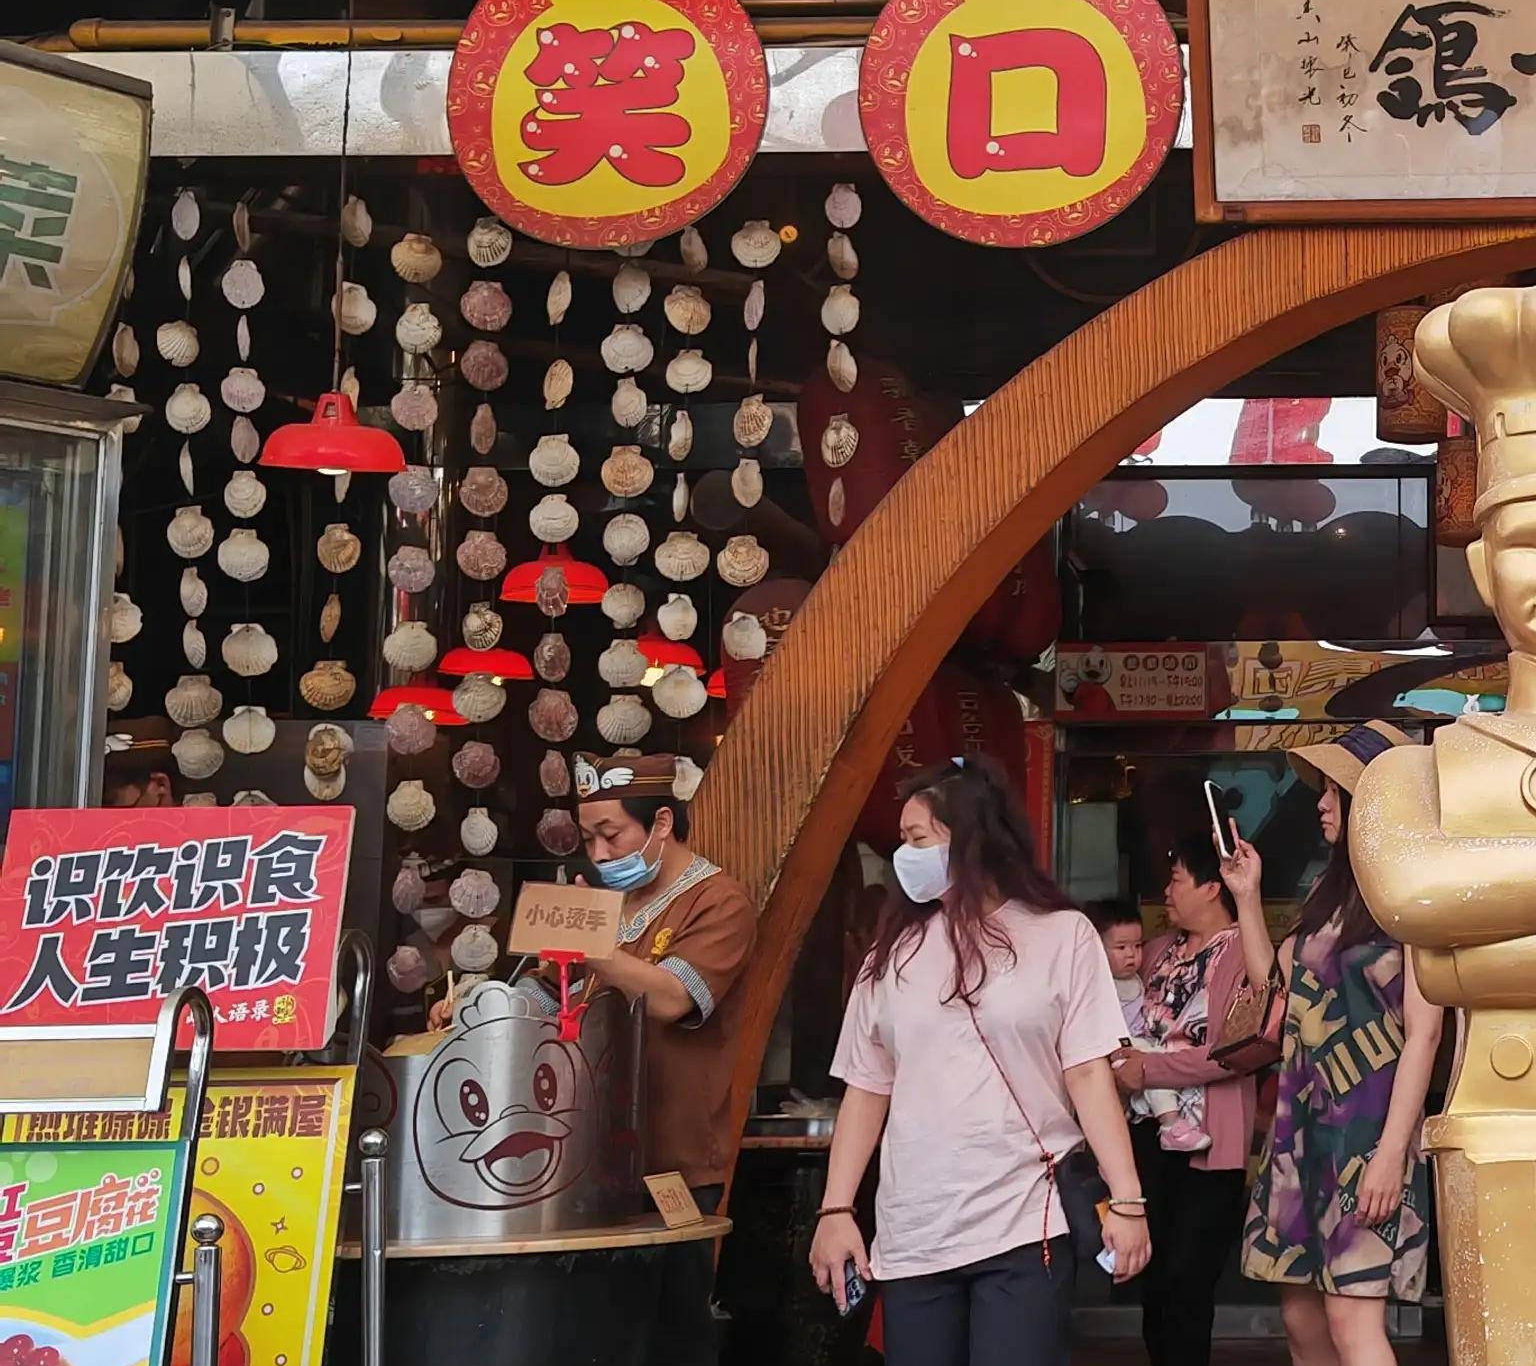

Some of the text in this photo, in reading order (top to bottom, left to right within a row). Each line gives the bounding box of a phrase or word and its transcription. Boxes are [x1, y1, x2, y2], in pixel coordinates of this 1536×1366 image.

[518, 21, 695, 186] 笑
[947, 28, 1107, 180] 口
[22, 830, 327, 929] 识饮识食
[526, 903, 608, 931] 小心烫手
[0, 908, 313, 1015] 人生积极
[52, 1232, 154, 1278] 香滑甜口
